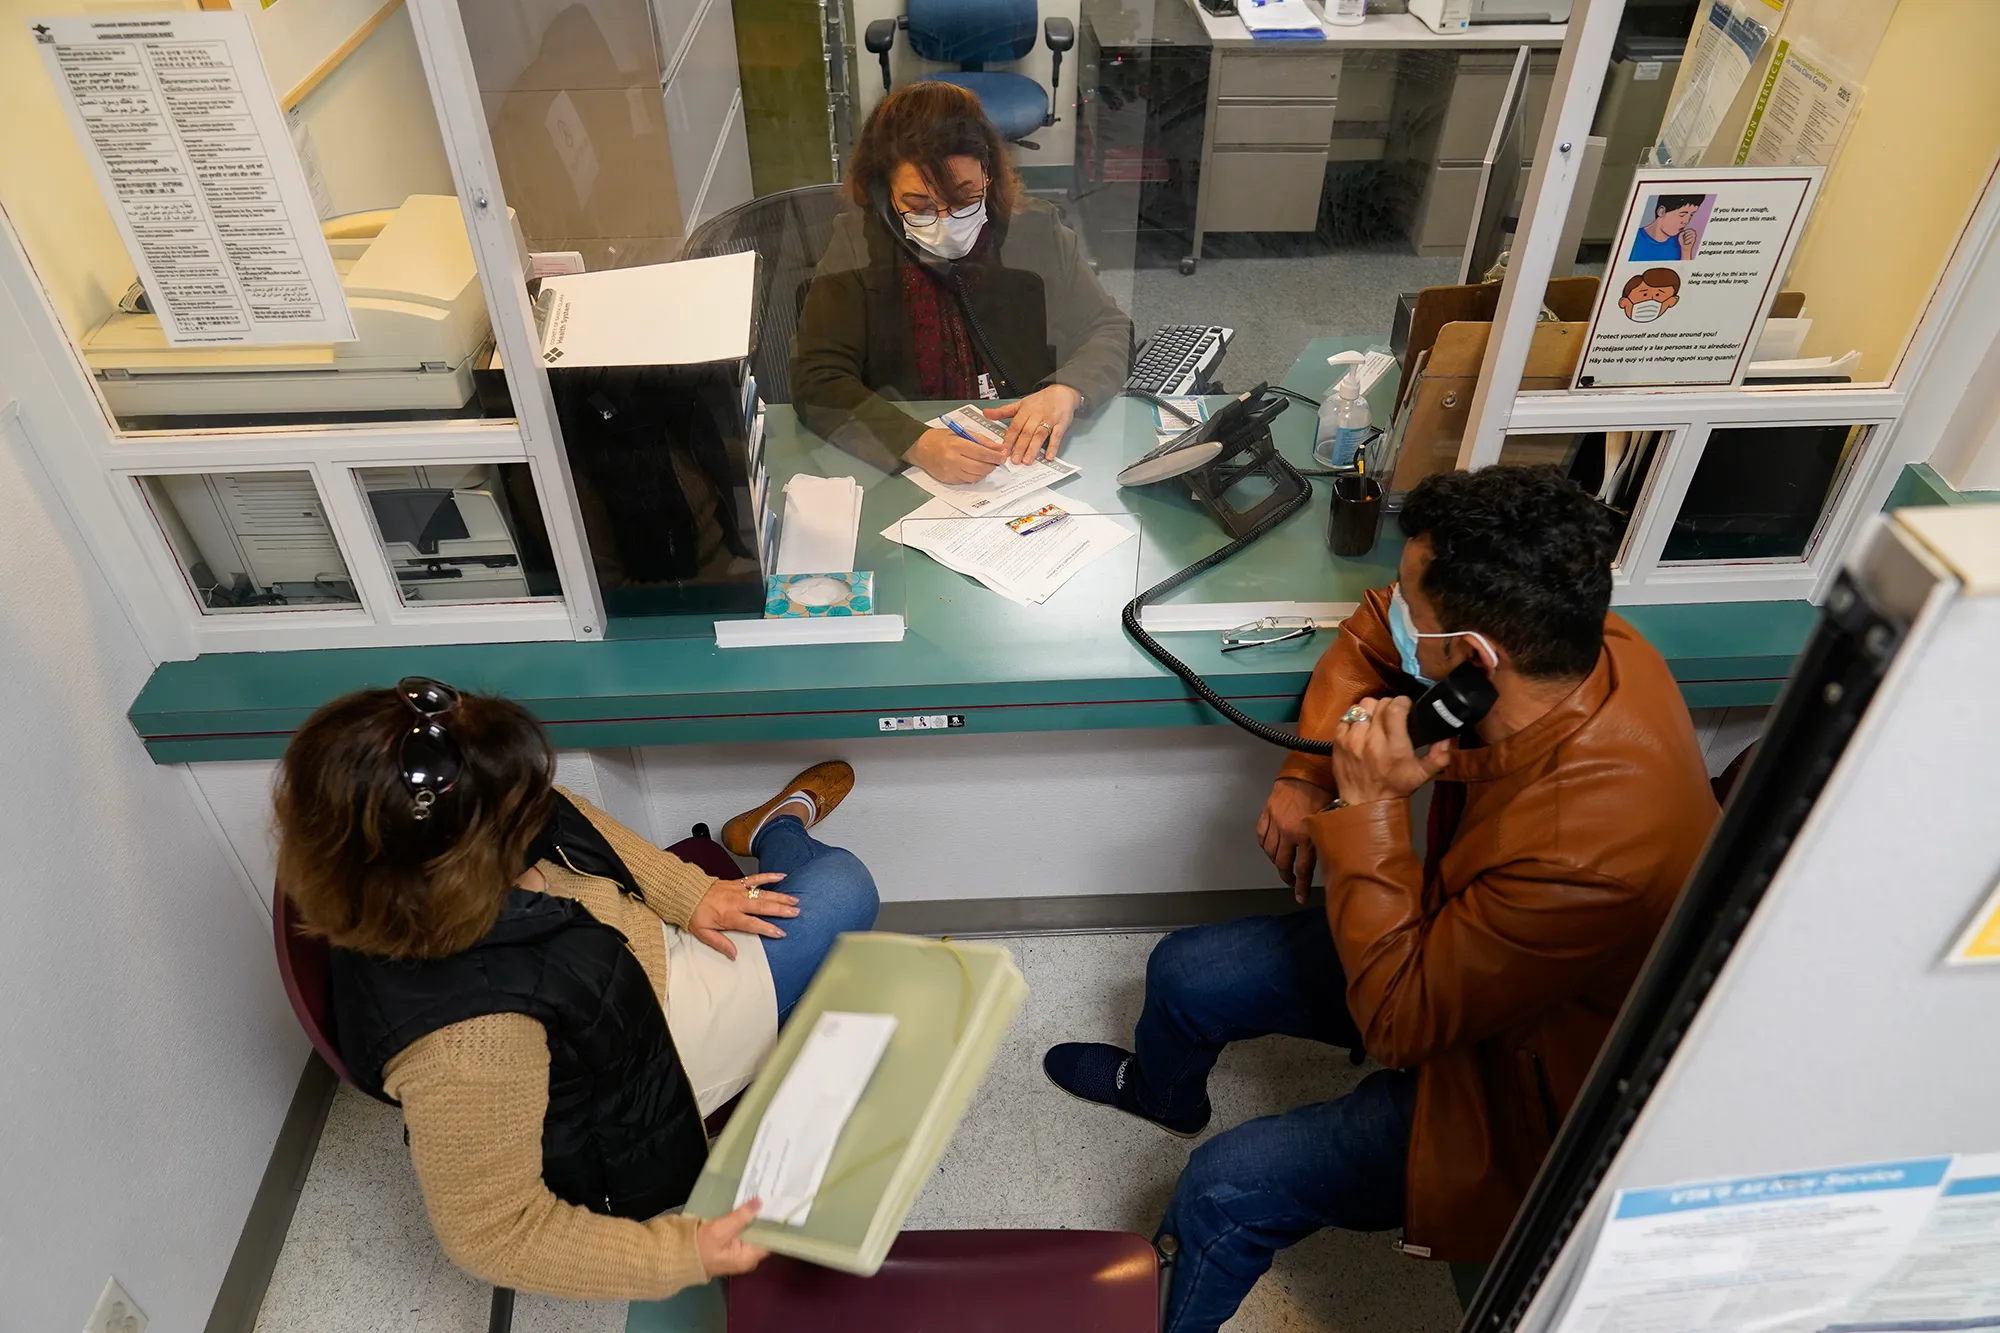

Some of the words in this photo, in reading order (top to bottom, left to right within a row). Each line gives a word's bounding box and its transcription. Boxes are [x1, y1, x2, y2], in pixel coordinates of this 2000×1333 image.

[1757, 51, 1784, 112] SERVICES
[556, 324, 566, 344] Health
[561, 301, 571, 324] System
[1620, 332, 1647, 340] yourself
